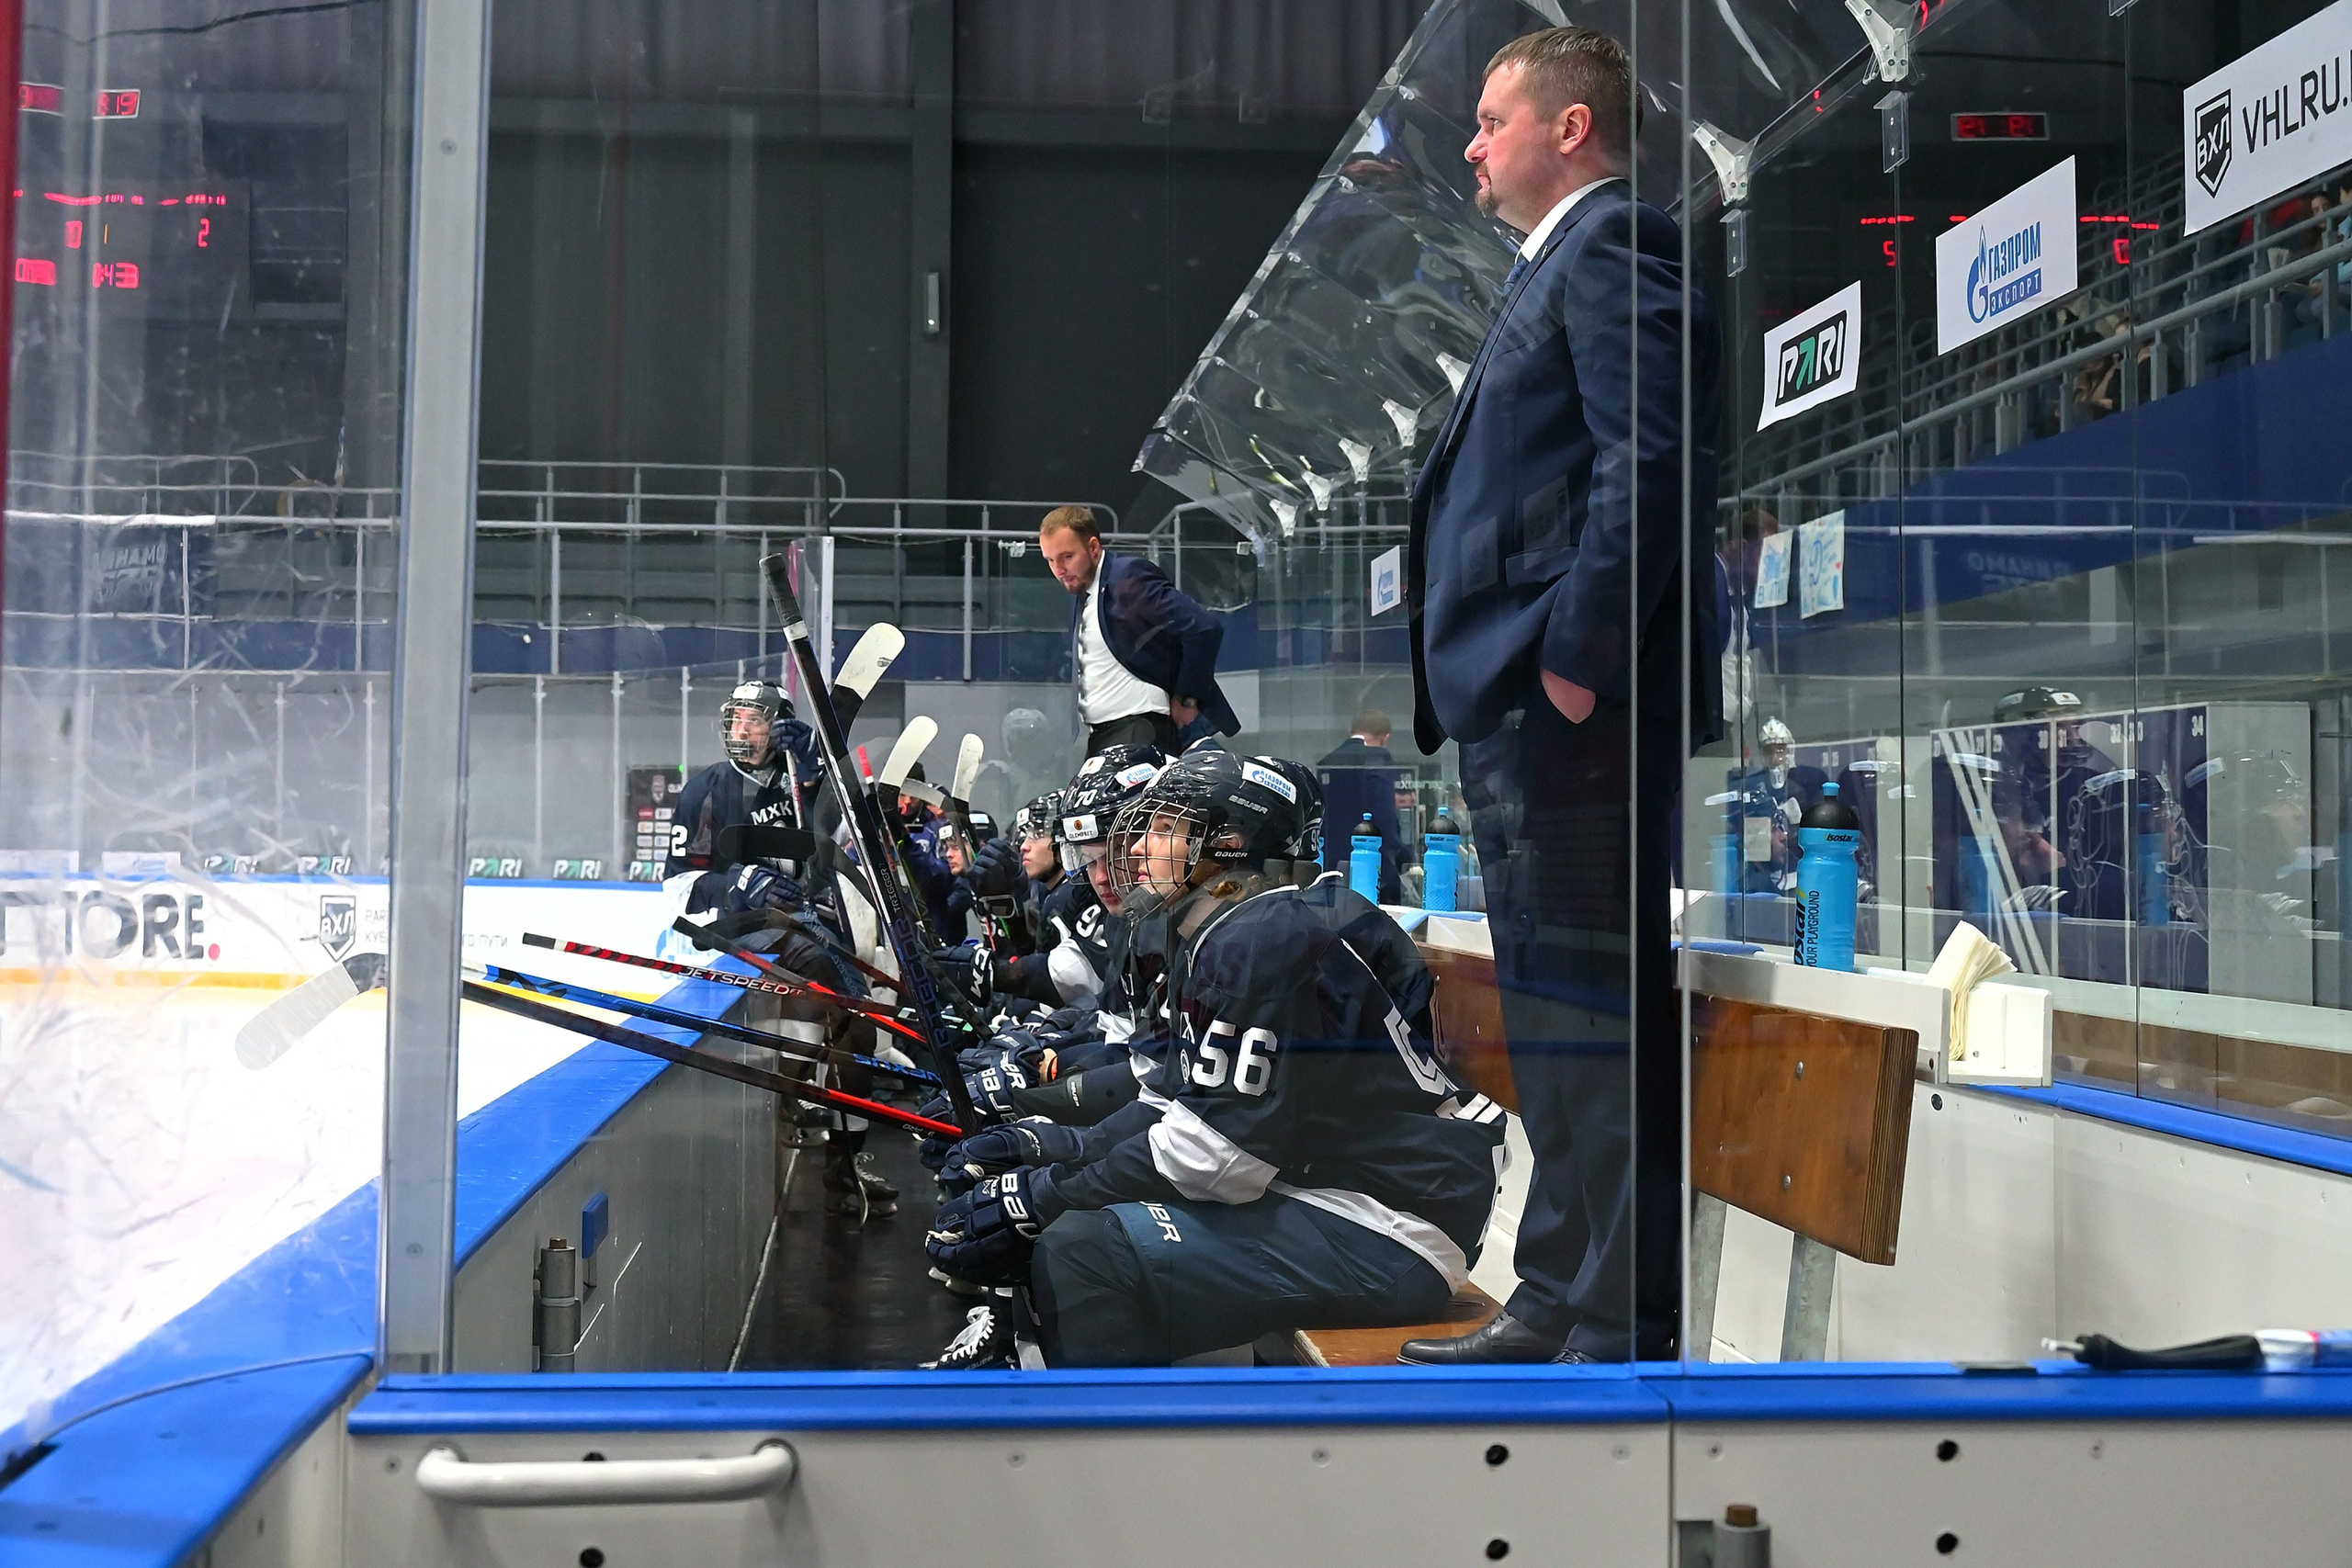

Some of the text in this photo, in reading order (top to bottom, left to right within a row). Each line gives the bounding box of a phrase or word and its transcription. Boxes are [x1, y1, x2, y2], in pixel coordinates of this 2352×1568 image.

[2242, 50, 2352, 154] VHLRU.
[2197, 112, 2231, 173] ВХЛ
[198, 218, 209, 248] 2
[1988, 220, 2041, 284] ГАЗПРОМ
[1991, 274, 2041, 313] ЭКСПОРТ
[1779, 320, 1844, 399] PARI
[1073, 789, 1098, 808] 70
[469, 857, 522, 877] PARI
[553, 860, 601, 879] PARI
[628, 861, 665, 881] PAR
[1808, 890, 1821, 925] PLAYGROUND
[678, 965, 789, 995] JETSPEED
[1192, 1019, 1279, 1097] 56
